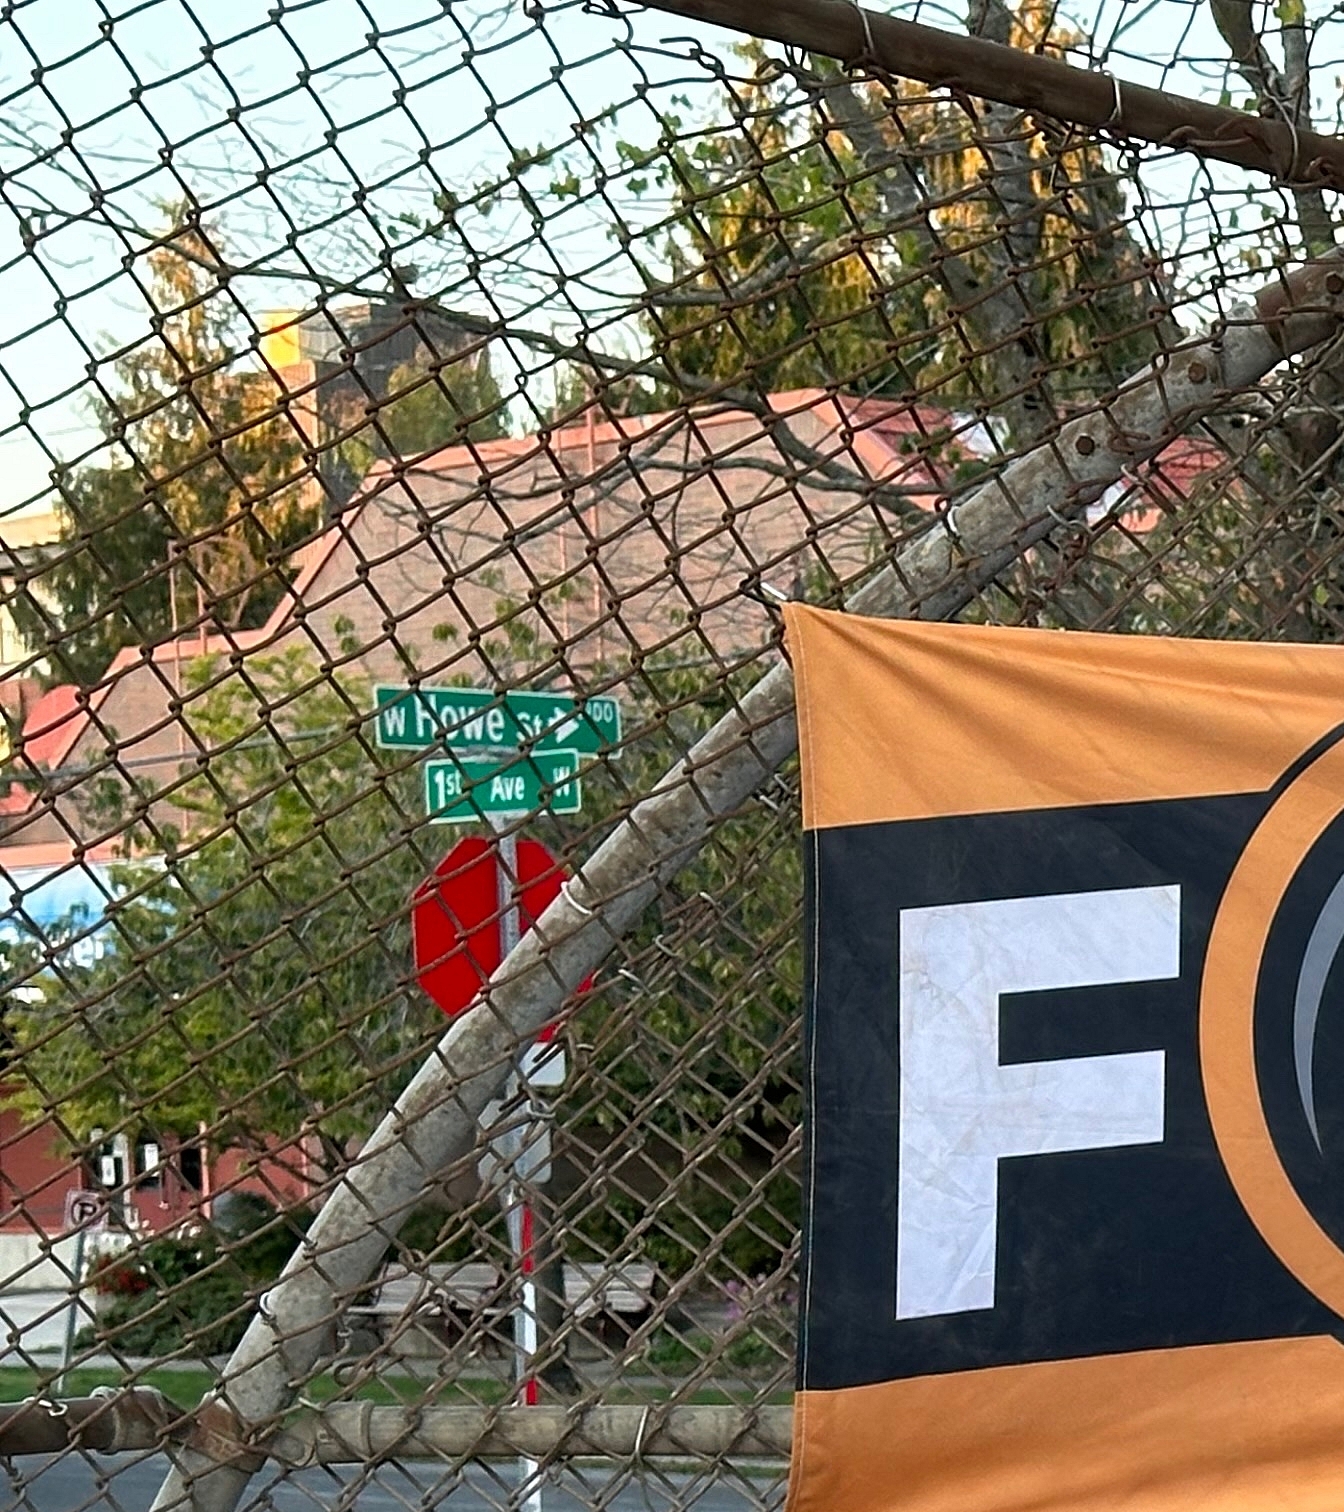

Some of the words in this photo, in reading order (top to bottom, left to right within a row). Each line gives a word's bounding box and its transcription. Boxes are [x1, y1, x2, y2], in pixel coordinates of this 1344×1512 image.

[384, 706, 406, 737] W
[414, 692, 505, 742] Howe
[516, 711, 547, 744] St
[434, 769, 463, 809] 1st
[490, 775, 525, 802] Ave
[553, 765, 571, 797] W
